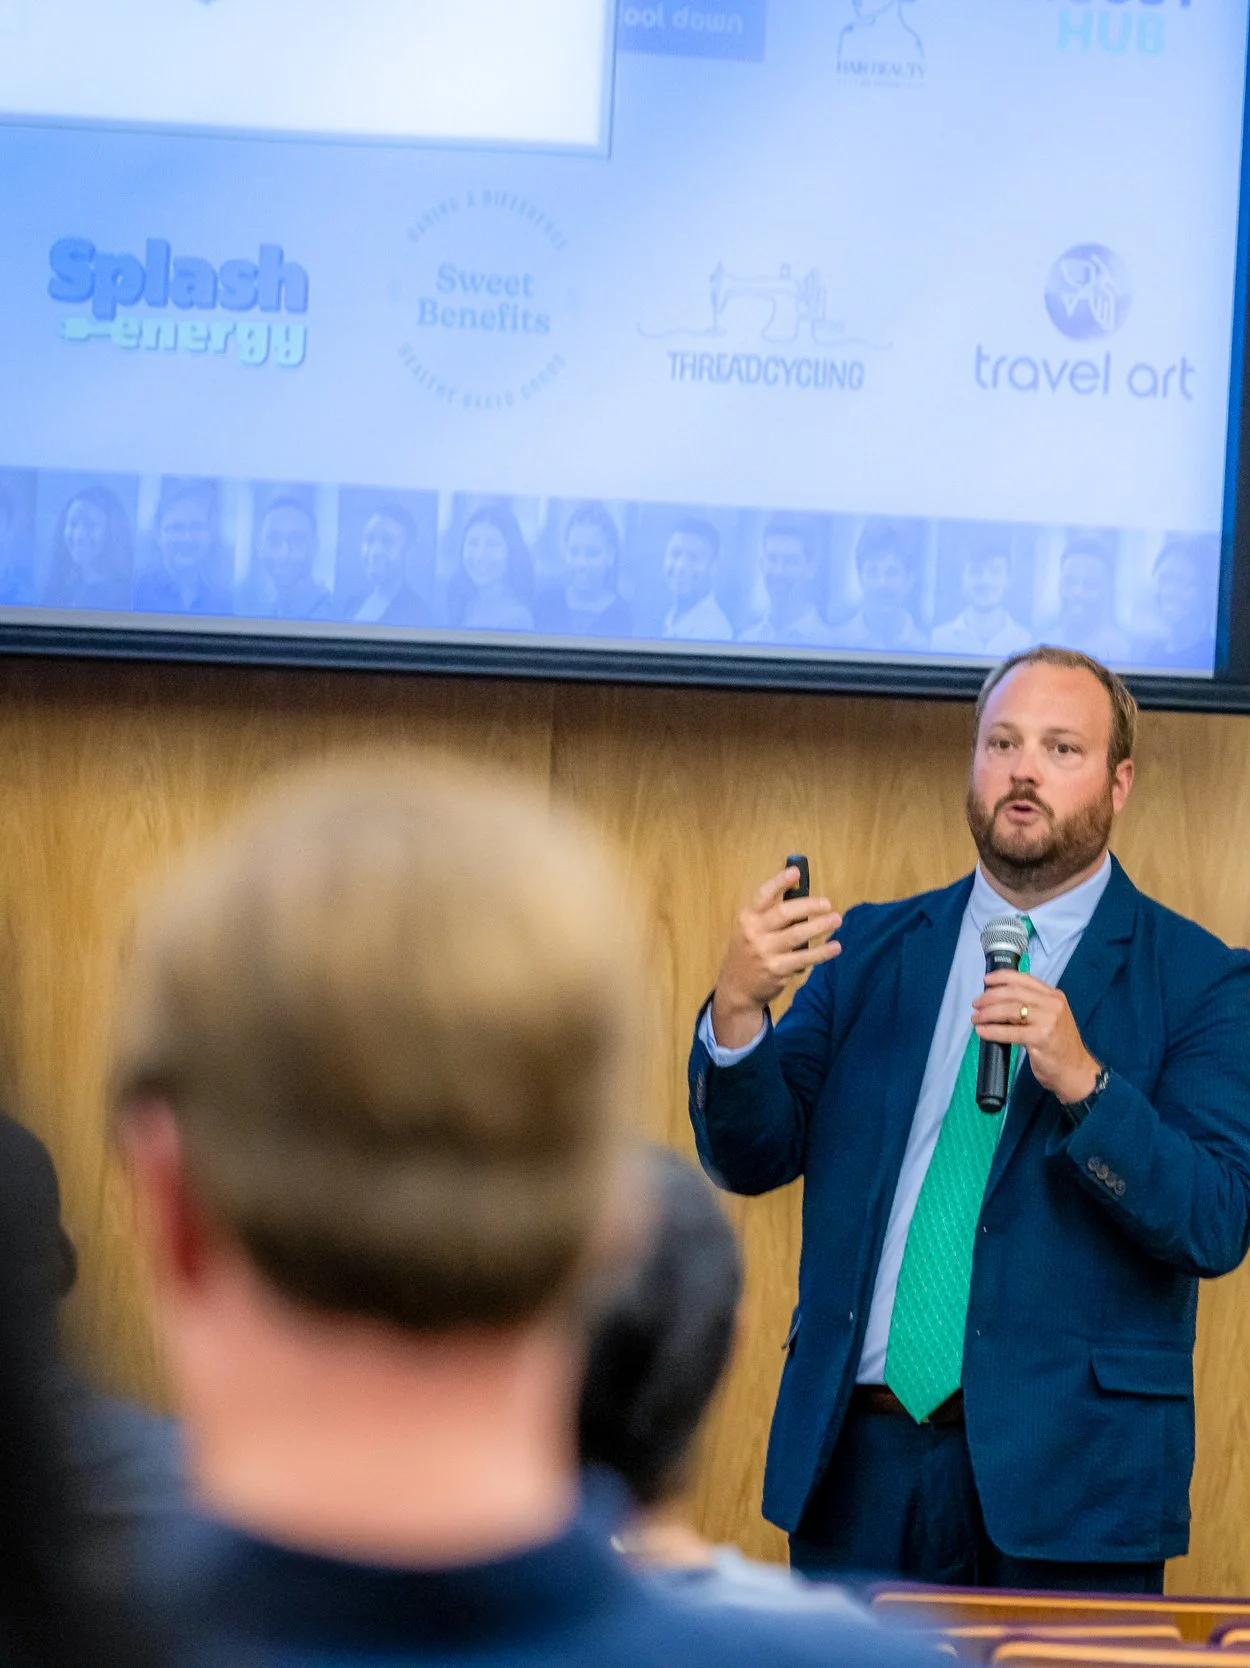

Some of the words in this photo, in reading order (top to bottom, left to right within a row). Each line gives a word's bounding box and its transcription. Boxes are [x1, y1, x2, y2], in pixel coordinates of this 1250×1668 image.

[619, 1, 665, 29] ool
[671, 4, 746, 35] down
[1057, 7, 1167, 57] HUB
[48, 236, 309, 321] Splash
[435, 262, 536, 300] Sweet
[111, 315, 307, 367] energy
[416, 296, 552, 337] Benefits
[974, 343, 1112, 396] travel
[1127, 355, 1197, 402] art
